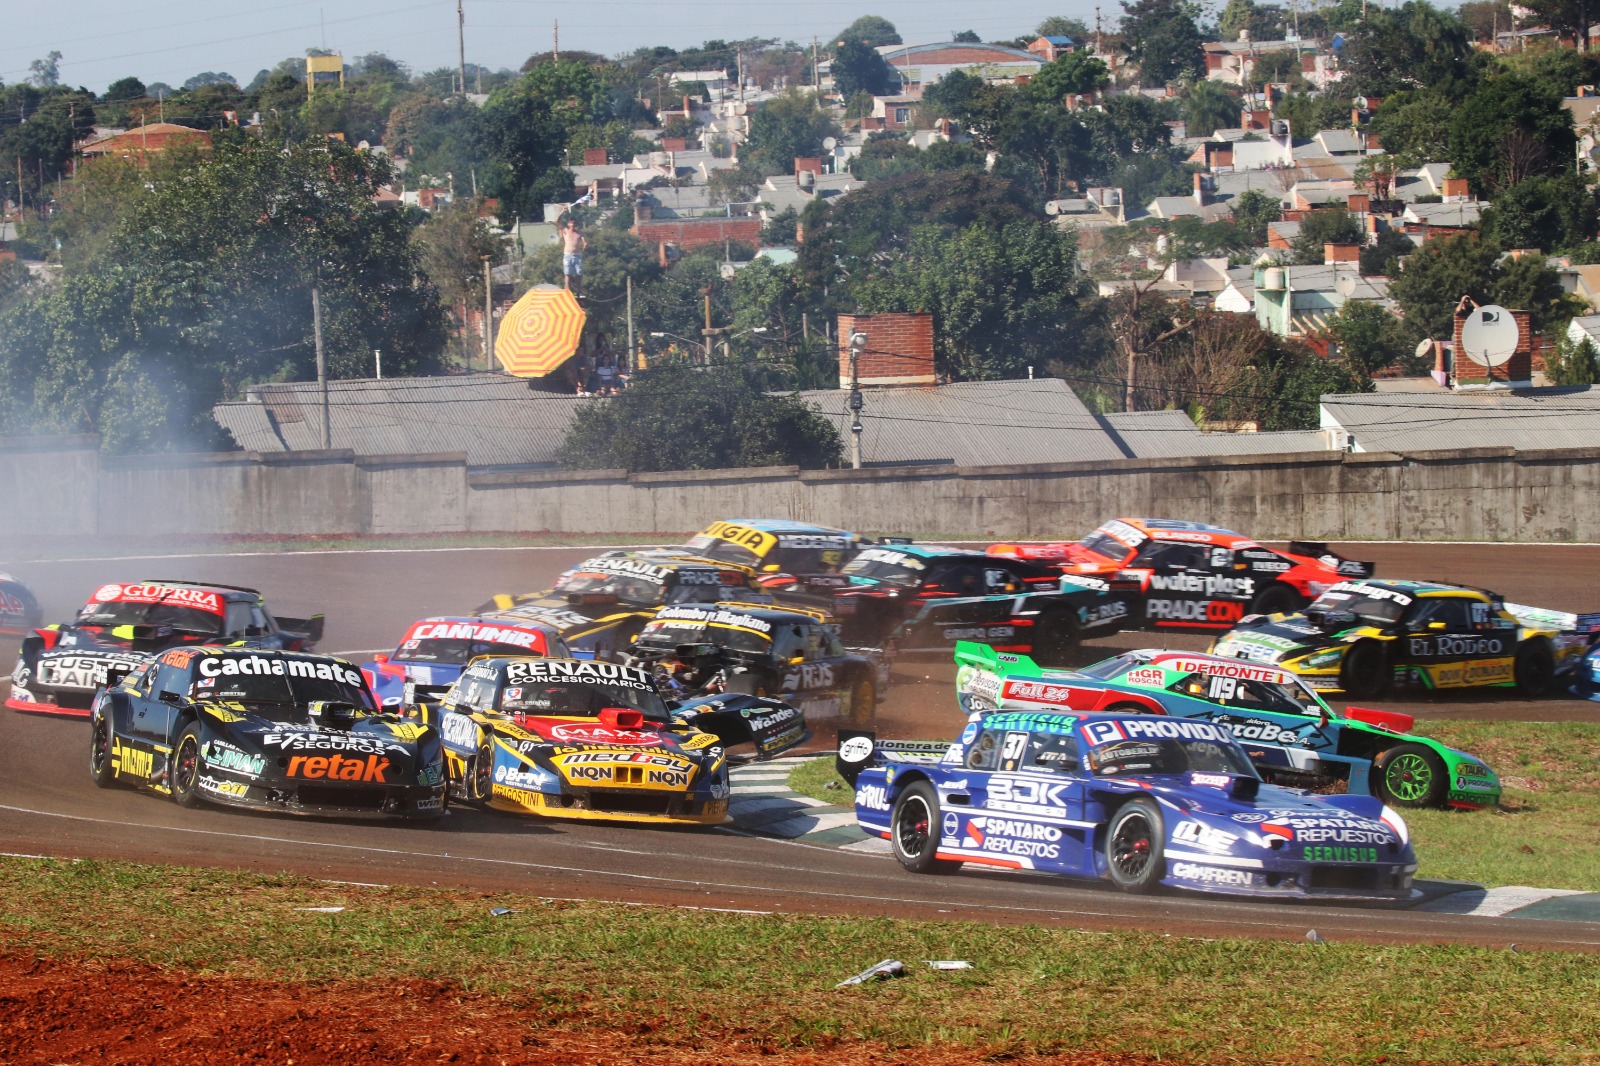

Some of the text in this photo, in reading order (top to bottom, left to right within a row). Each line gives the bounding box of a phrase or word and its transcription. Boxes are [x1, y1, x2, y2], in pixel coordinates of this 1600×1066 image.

[585, 558, 674, 579] RENAULT
[123, 584, 218, 608] GUERRA
[1146, 599, 1244, 622] PRADECON
[412, 622, 537, 649] CAÑUMIR
[199, 655, 362, 688] Cachamate
[506, 662, 653, 684] RENAULT
[1128, 669, 1163, 680] HGR
[1128, 677, 1163, 686] ROSCAL
[1184, 662, 1275, 683] DEMONTE
[509, 675, 654, 693] CONCESIONARIOS
[1009, 682, 1070, 702] Full 24
[1208, 676, 1237, 700] 119
[748, 708, 795, 732] Wander
[982, 713, 1078, 734] SERVISUB
[263, 732, 412, 758] EXPERTA
[292, 740, 387, 756] SEGUROS
[1002, 733, 1028, 760] 37
[286, 753, 391, 783] retak
[563, 751, 696, 775] medbay
[505, 767, 546, 787] BPN
[570, 766, 688, 787] NQN NQN
[985, 819, 1063, 842] SPATARO
[1289, 818, 1390, 834] SPATARO
[982, 836, 1061, 859] REPUESTOS
[1303, 846, 1378, 863] SERVISUB
